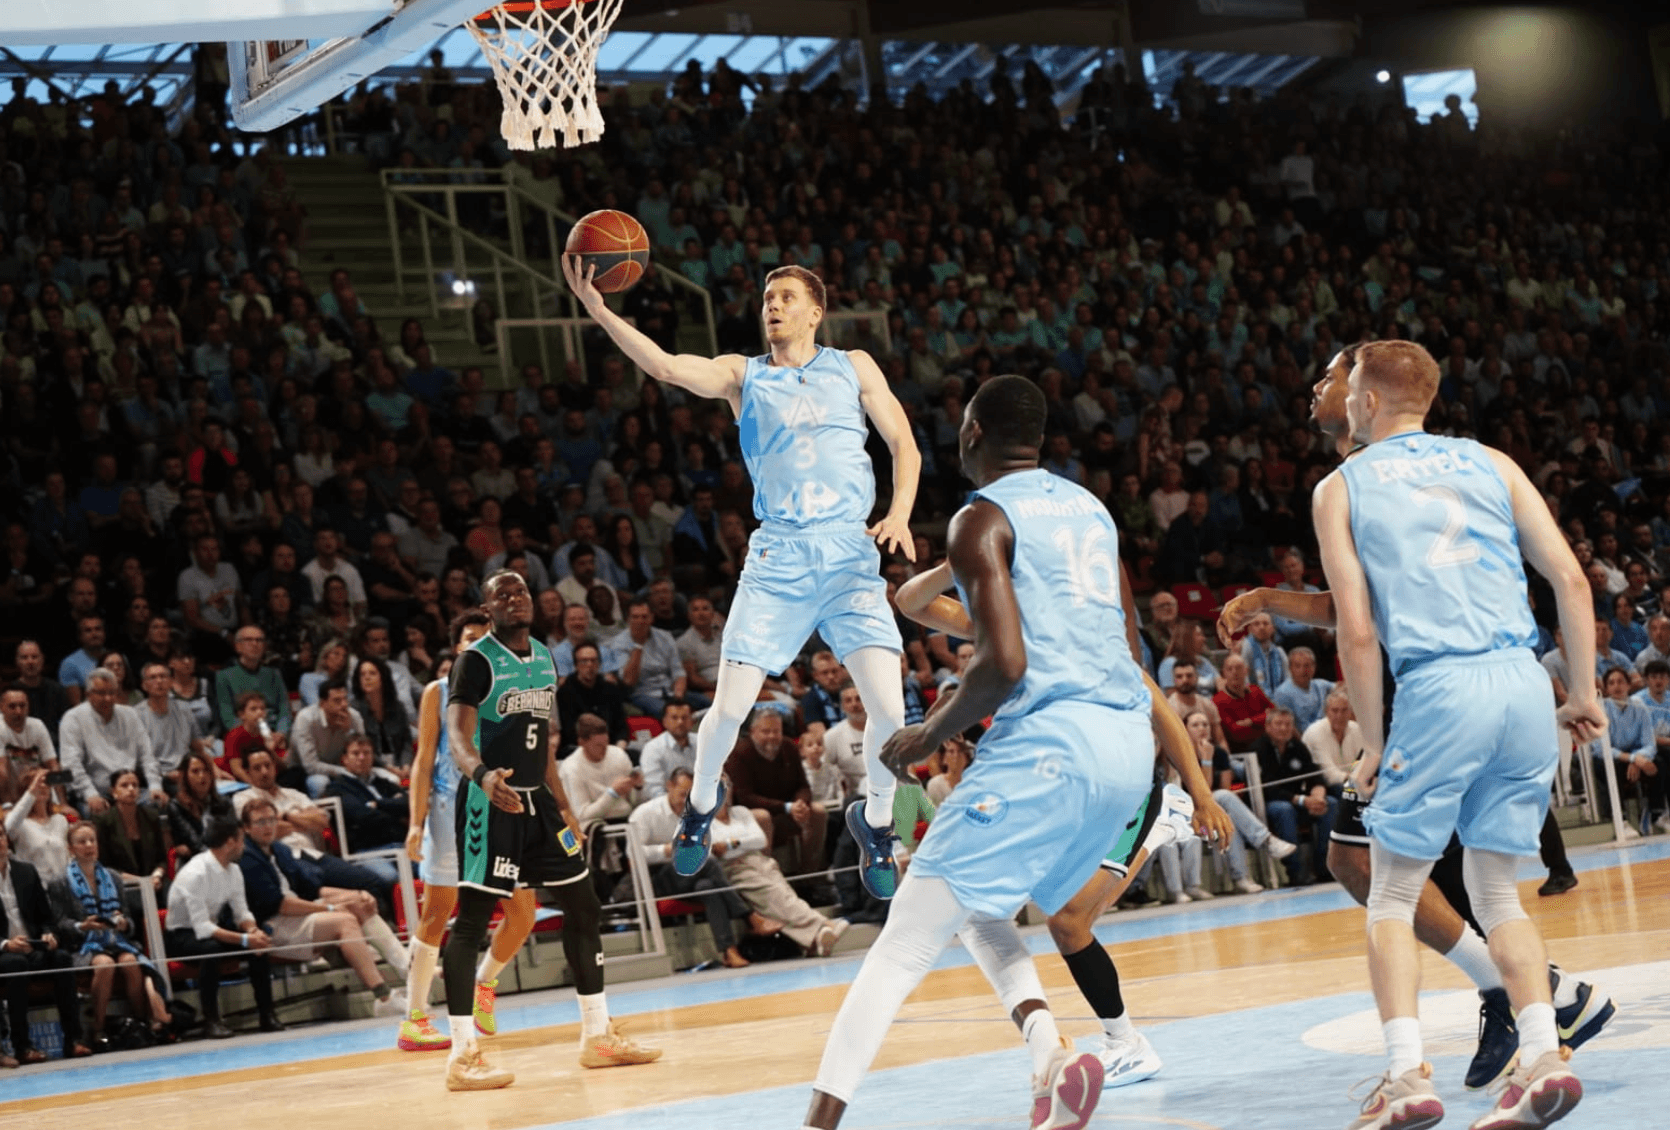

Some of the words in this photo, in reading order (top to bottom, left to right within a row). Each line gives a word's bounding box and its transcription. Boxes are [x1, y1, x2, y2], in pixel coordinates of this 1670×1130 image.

[794, 435, 817, 469] 3
[1409, 484, 1481, 569] 2
[1051, 522, 1118, 608] 16
[525, 723, 539, 750] 5
